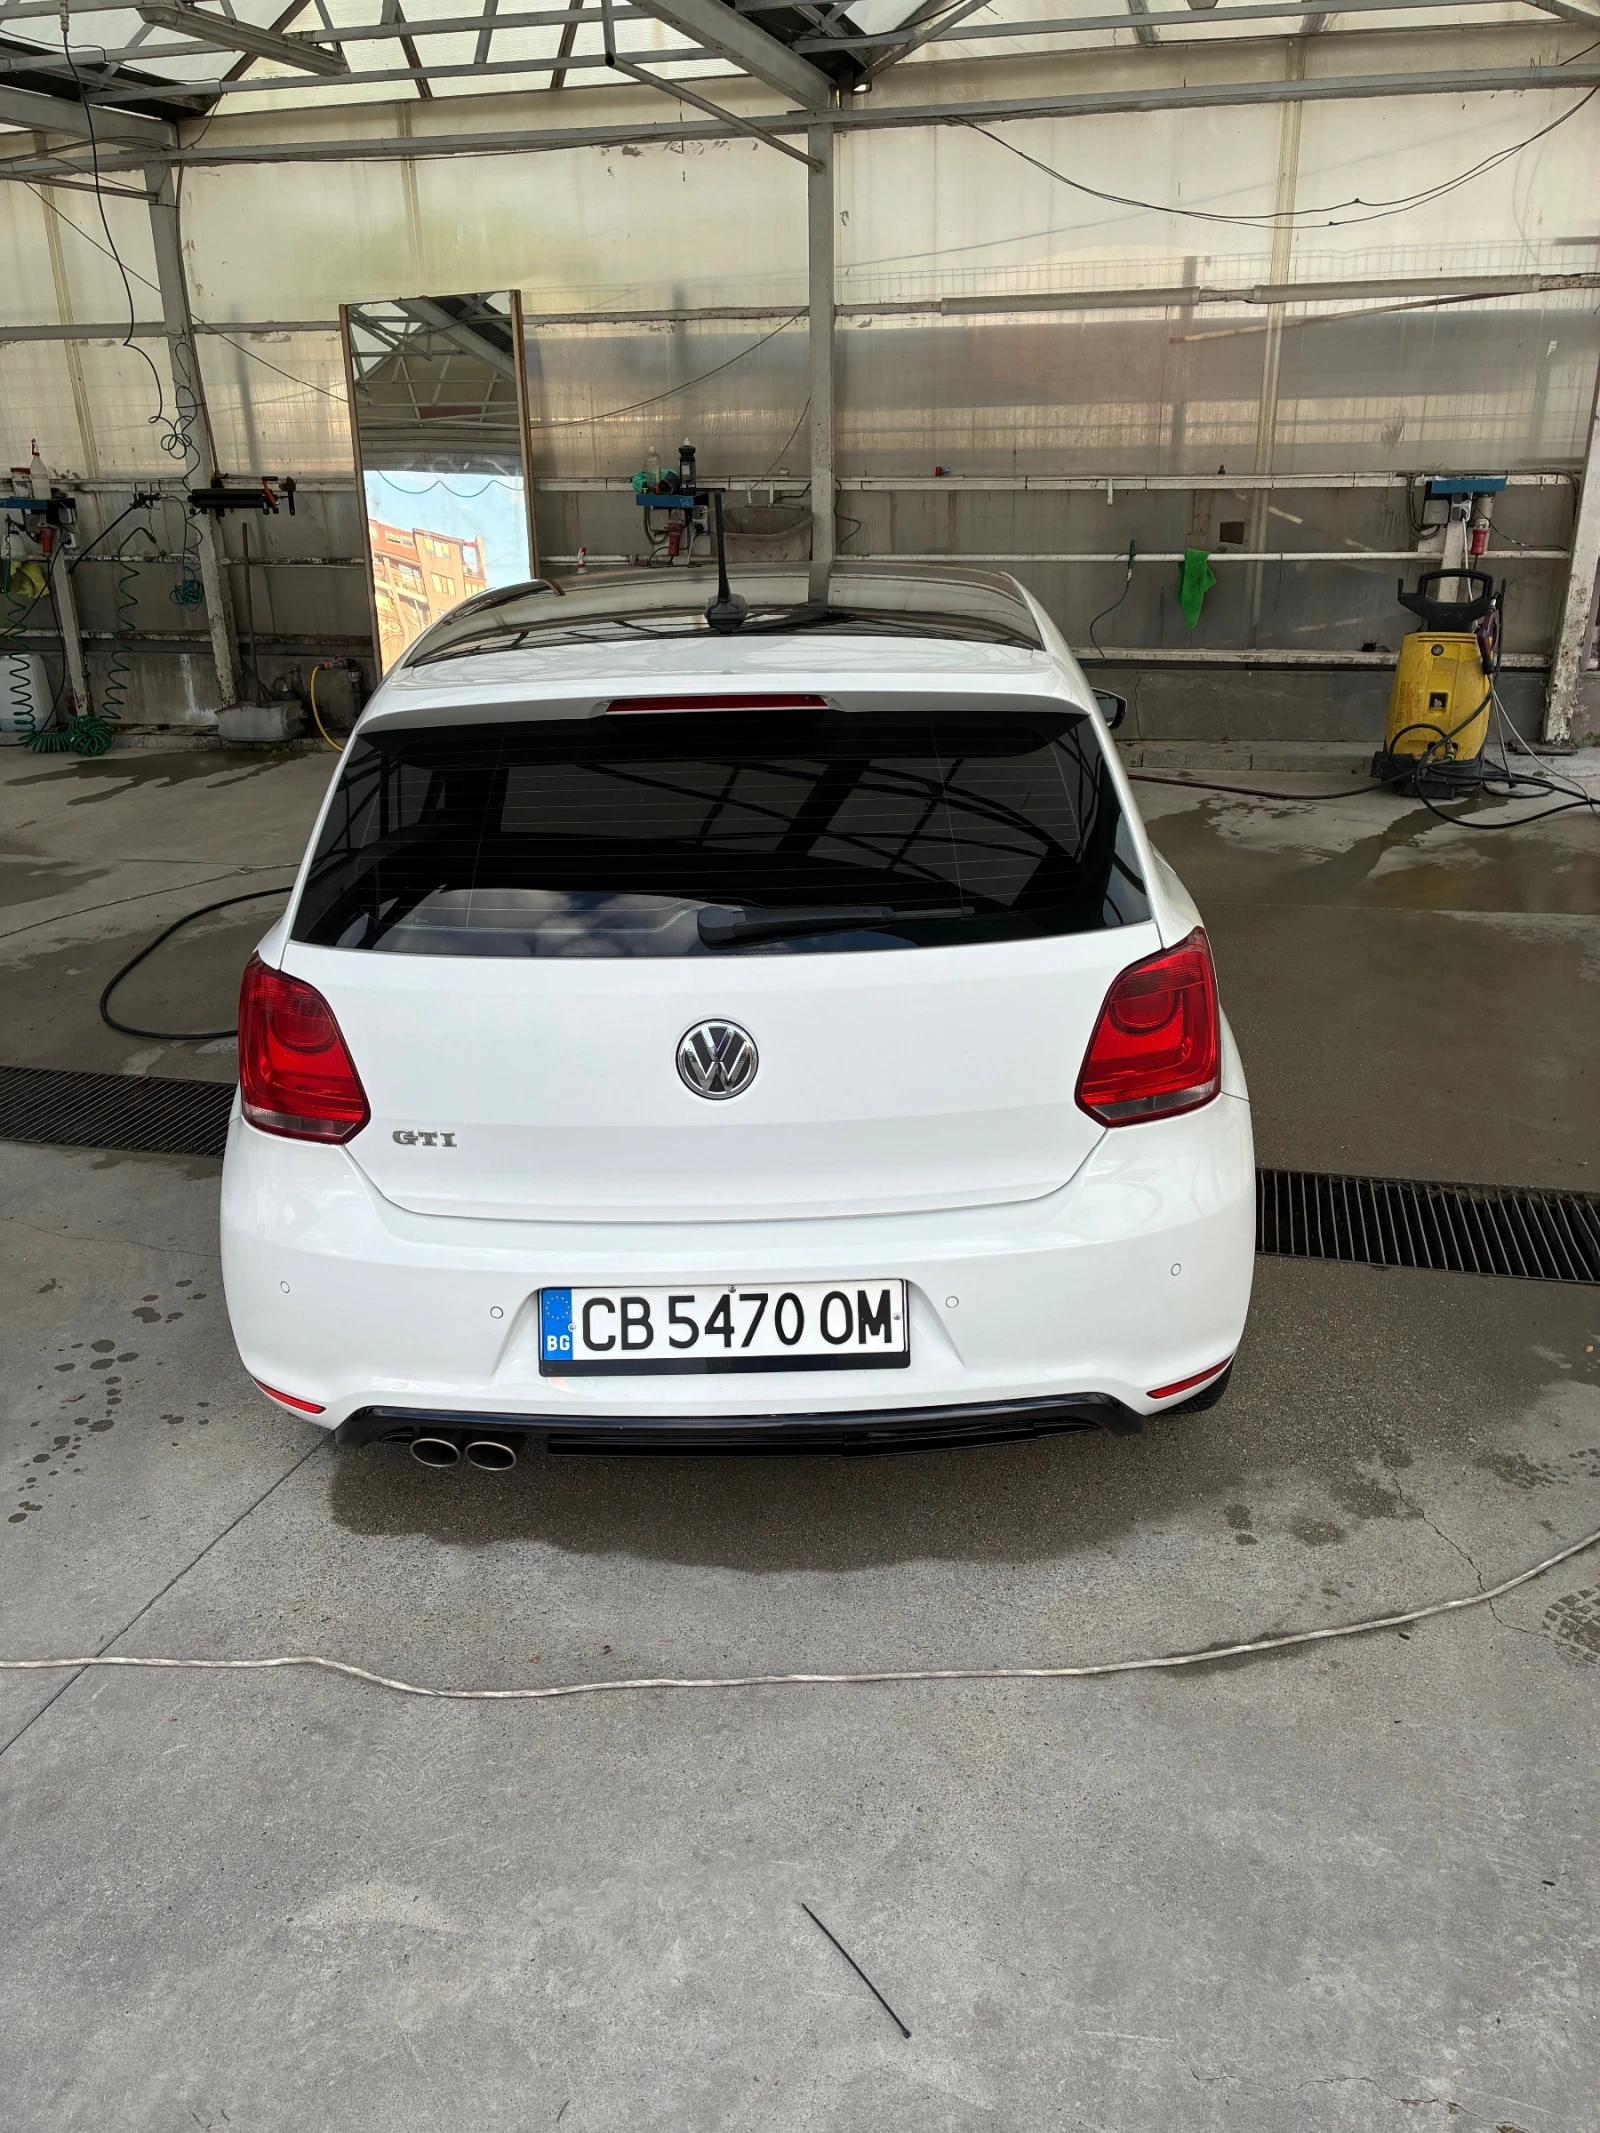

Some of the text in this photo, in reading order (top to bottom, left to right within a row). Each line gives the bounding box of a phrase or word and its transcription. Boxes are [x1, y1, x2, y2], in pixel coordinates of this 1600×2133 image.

[676, 1019, 759, 1100] VW
[392, 1129, 457, 1148] GTI
[581, 1289, 892, 1352] CB 5470 OM
[547, 1335, 570, 1351] BG
